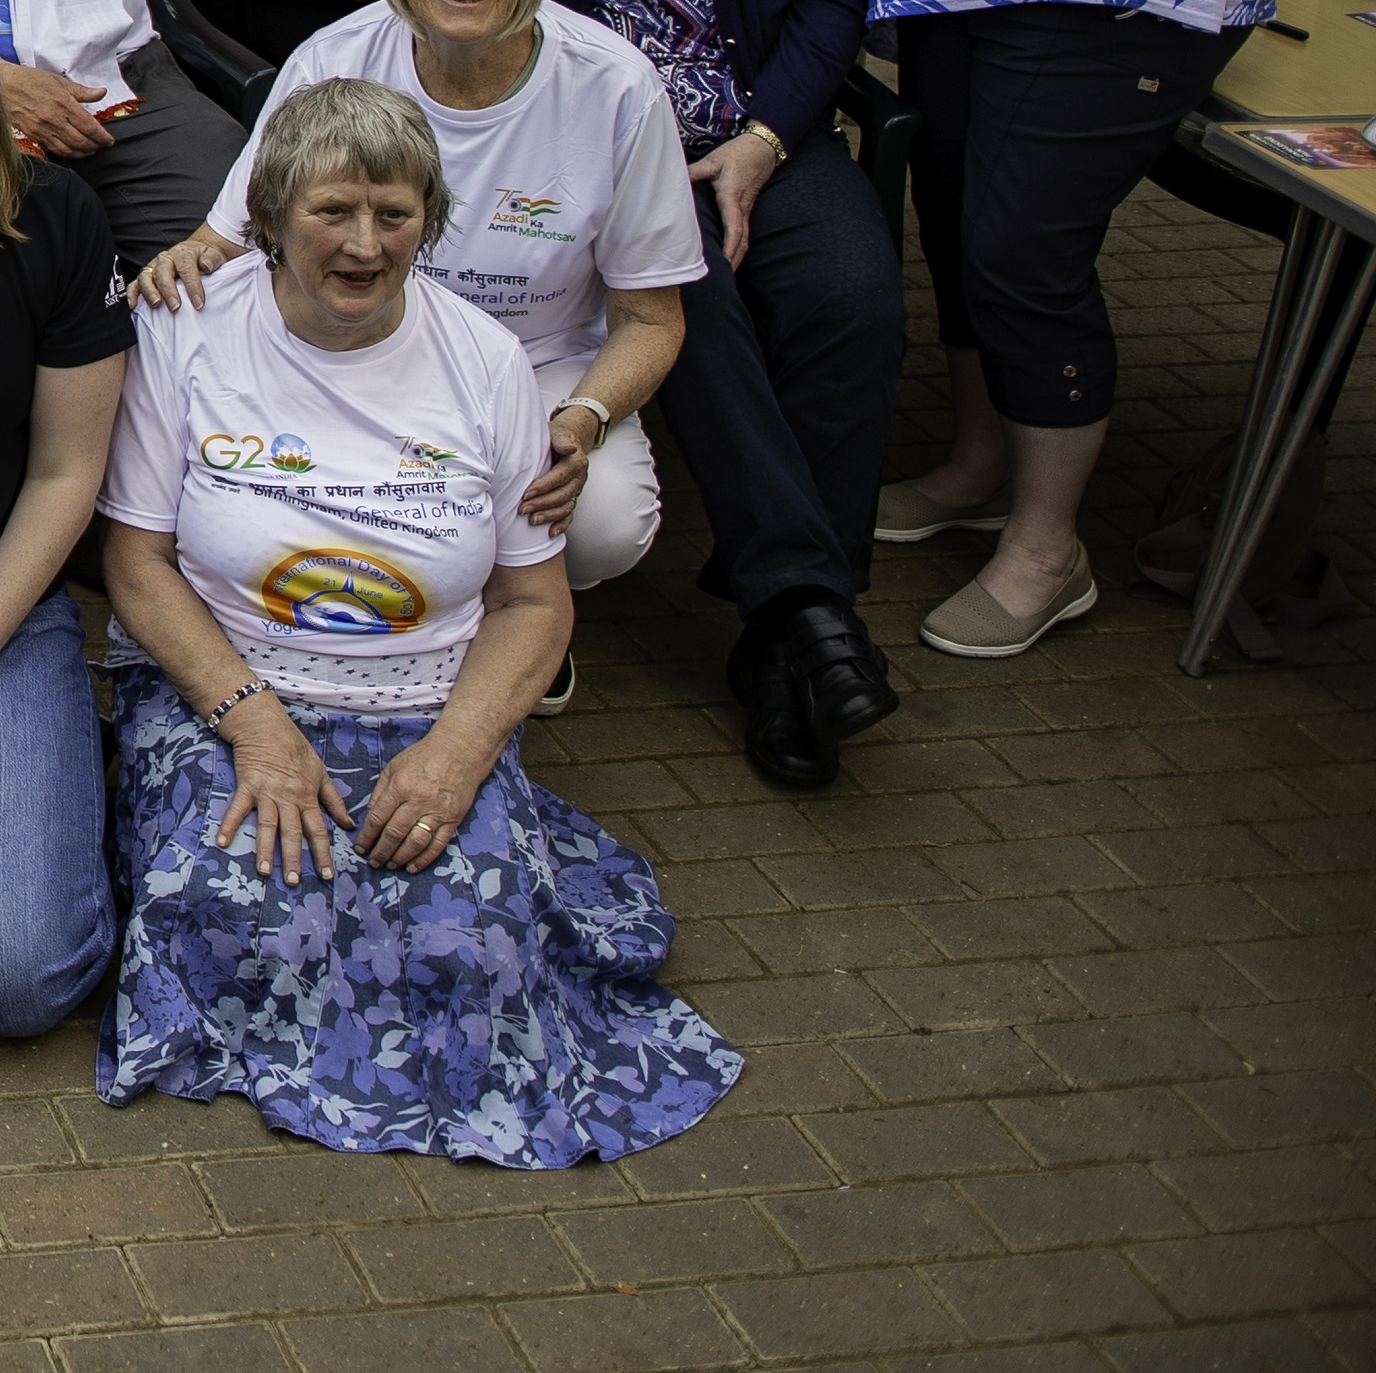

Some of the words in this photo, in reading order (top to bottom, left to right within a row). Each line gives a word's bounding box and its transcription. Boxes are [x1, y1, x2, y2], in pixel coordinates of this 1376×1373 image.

[492, 212, 528, 223] Azadi
[530, 220, 543, 228] Ka
[488, 223, 517, 233] Amrit
[518, 228, 576, 242] Mahotsav
[457, 269, 529, 289] कौंसुलावास
[507, 291, 527, 304] of
[529, 287, 567, 304] India
[200, 433, 318, 472] G20
[399, 459, 434, 469] Azadi
[396, 470, 426, 479] Amrit
[297, 486, 316, 497] का
[325, 484, 365, 497] प्रधान
[373, 481, 446, 501] कौंसुलावास
[431, 502, 448, 518] of
[452, 501, 483, 517] India
[274, 555, 351, 593] nternational
[357, 560, 387, 582] Day
[390, 580, 409, 594] of
[323, 578, 336, 587] 21
[356, 586, 384, 599] June
